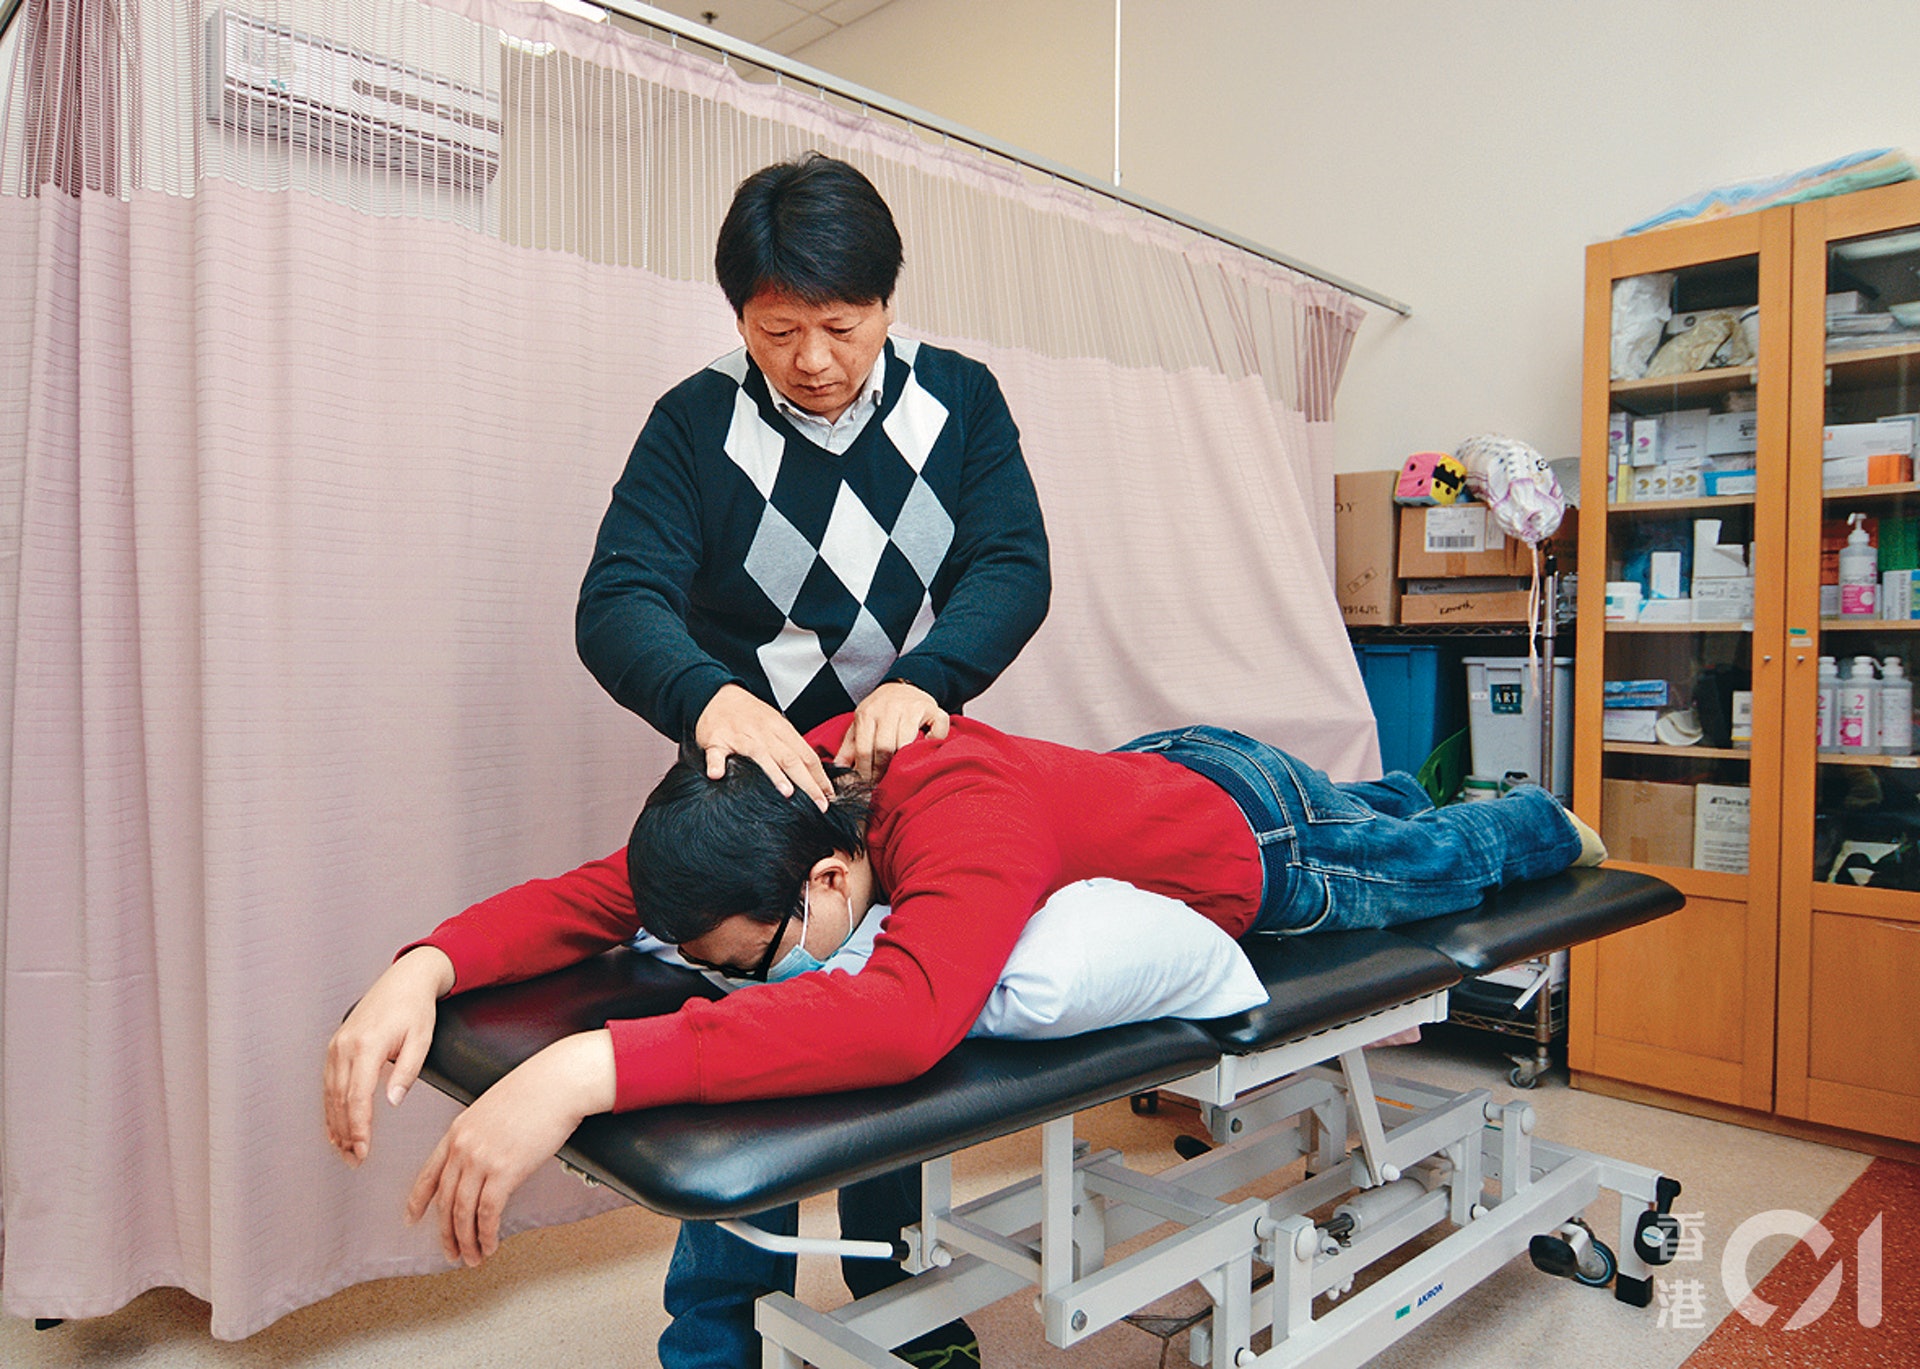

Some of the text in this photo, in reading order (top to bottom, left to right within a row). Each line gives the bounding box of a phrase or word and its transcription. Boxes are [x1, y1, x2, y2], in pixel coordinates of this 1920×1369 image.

[1495, 692, 1519, 704] ART
[1854, 693, 1865, 710] 2
[1417, 1282, 1444, 1307] AKRON
